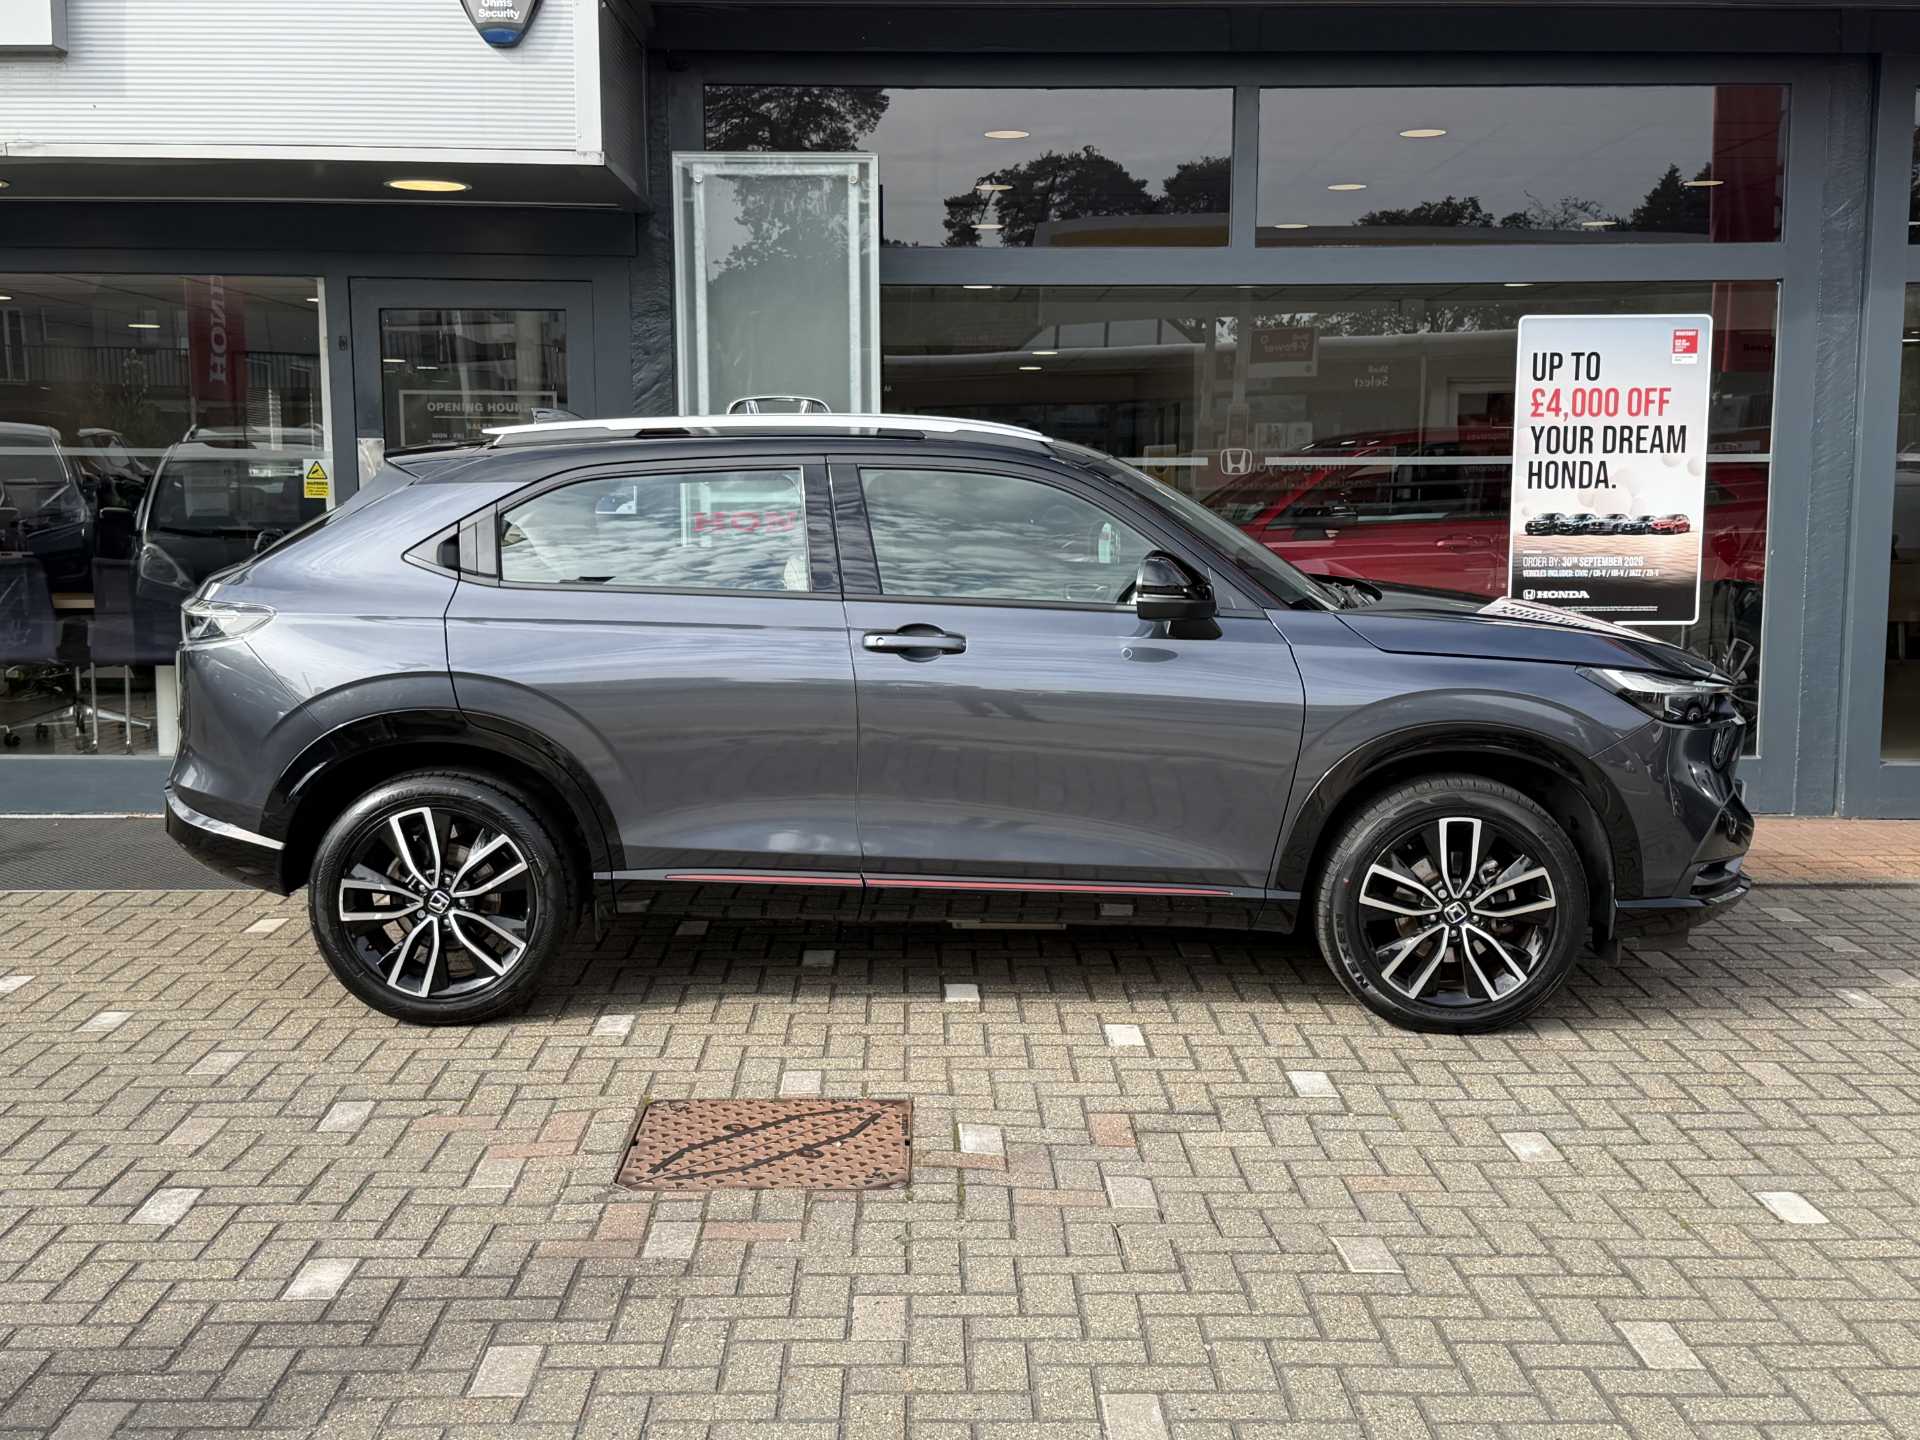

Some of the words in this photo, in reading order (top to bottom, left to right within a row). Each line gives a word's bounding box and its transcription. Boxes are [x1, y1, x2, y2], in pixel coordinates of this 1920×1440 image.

[478, 9, 520, 20] Security
[1532, 351, 1563, 381] UP
[1571, 351, 1601, 381] TO
[426, 402, 484, 412] OPENING
[1530, 387, 1620, 422] £4,000
[1627, 387, 1672, 417] OFF
[1530, 425, 1594, 454] YOUR
[1602, 425, 1687, 454] DREAM
[1528, 460, 1616, 489] HONDA.
[1522, 556, 1548, 567] ORDER
[1549, 556, 1561, 567] BY:
[1579, 556, 1623, 567] SEPTEMBER
[1624, 556, 1644, 567] 2026
[1536, 590, 1590, 599] HONDA
